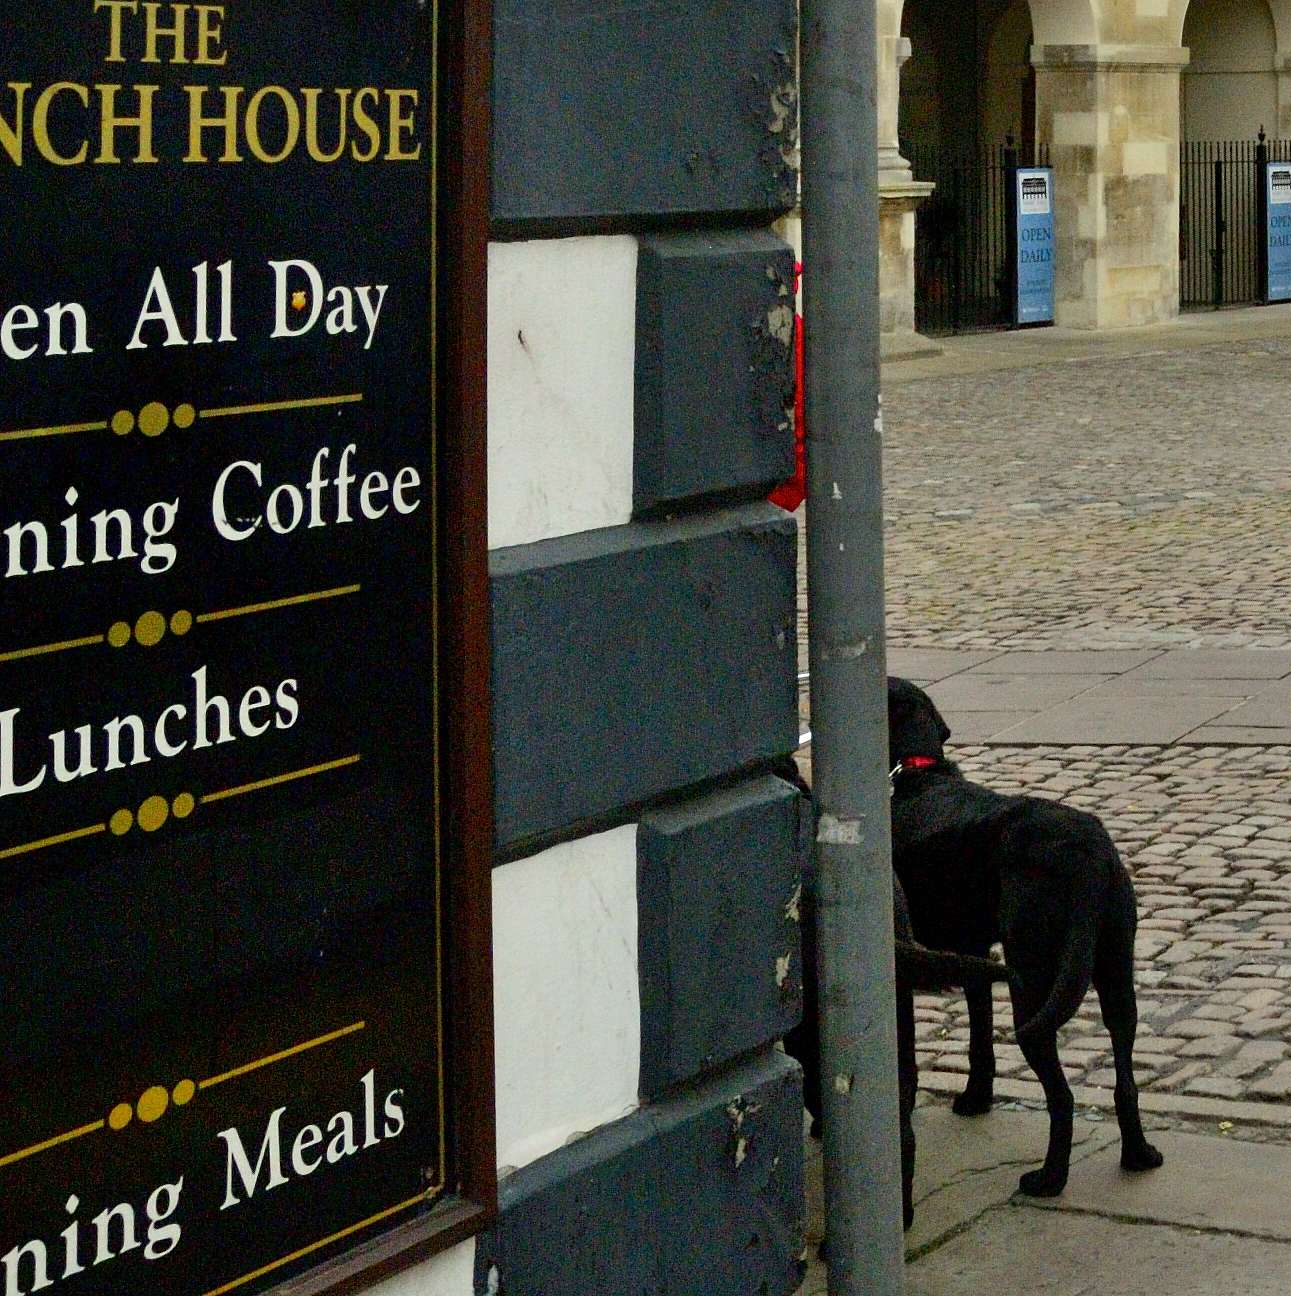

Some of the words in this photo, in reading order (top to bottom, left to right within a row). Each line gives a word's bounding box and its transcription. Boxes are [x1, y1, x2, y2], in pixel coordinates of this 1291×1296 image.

[182, 84, 421, 163] HOUSE
[1021, 227, 1051, 242] OPEN
[1021, 247, 1053, 264] DAILY
[0, 302, 94, 360] en
[125, 260, 238, 350] All
[267, 259, 389, 350] Day
[2, 486, 180, 575] ning
[211, 443, 421, 541] Coffee
[0, 665, 299, 797] Lunches
[0, 1175, 184, 1296] ning
[217, 1067, 405, 1211] Meals
